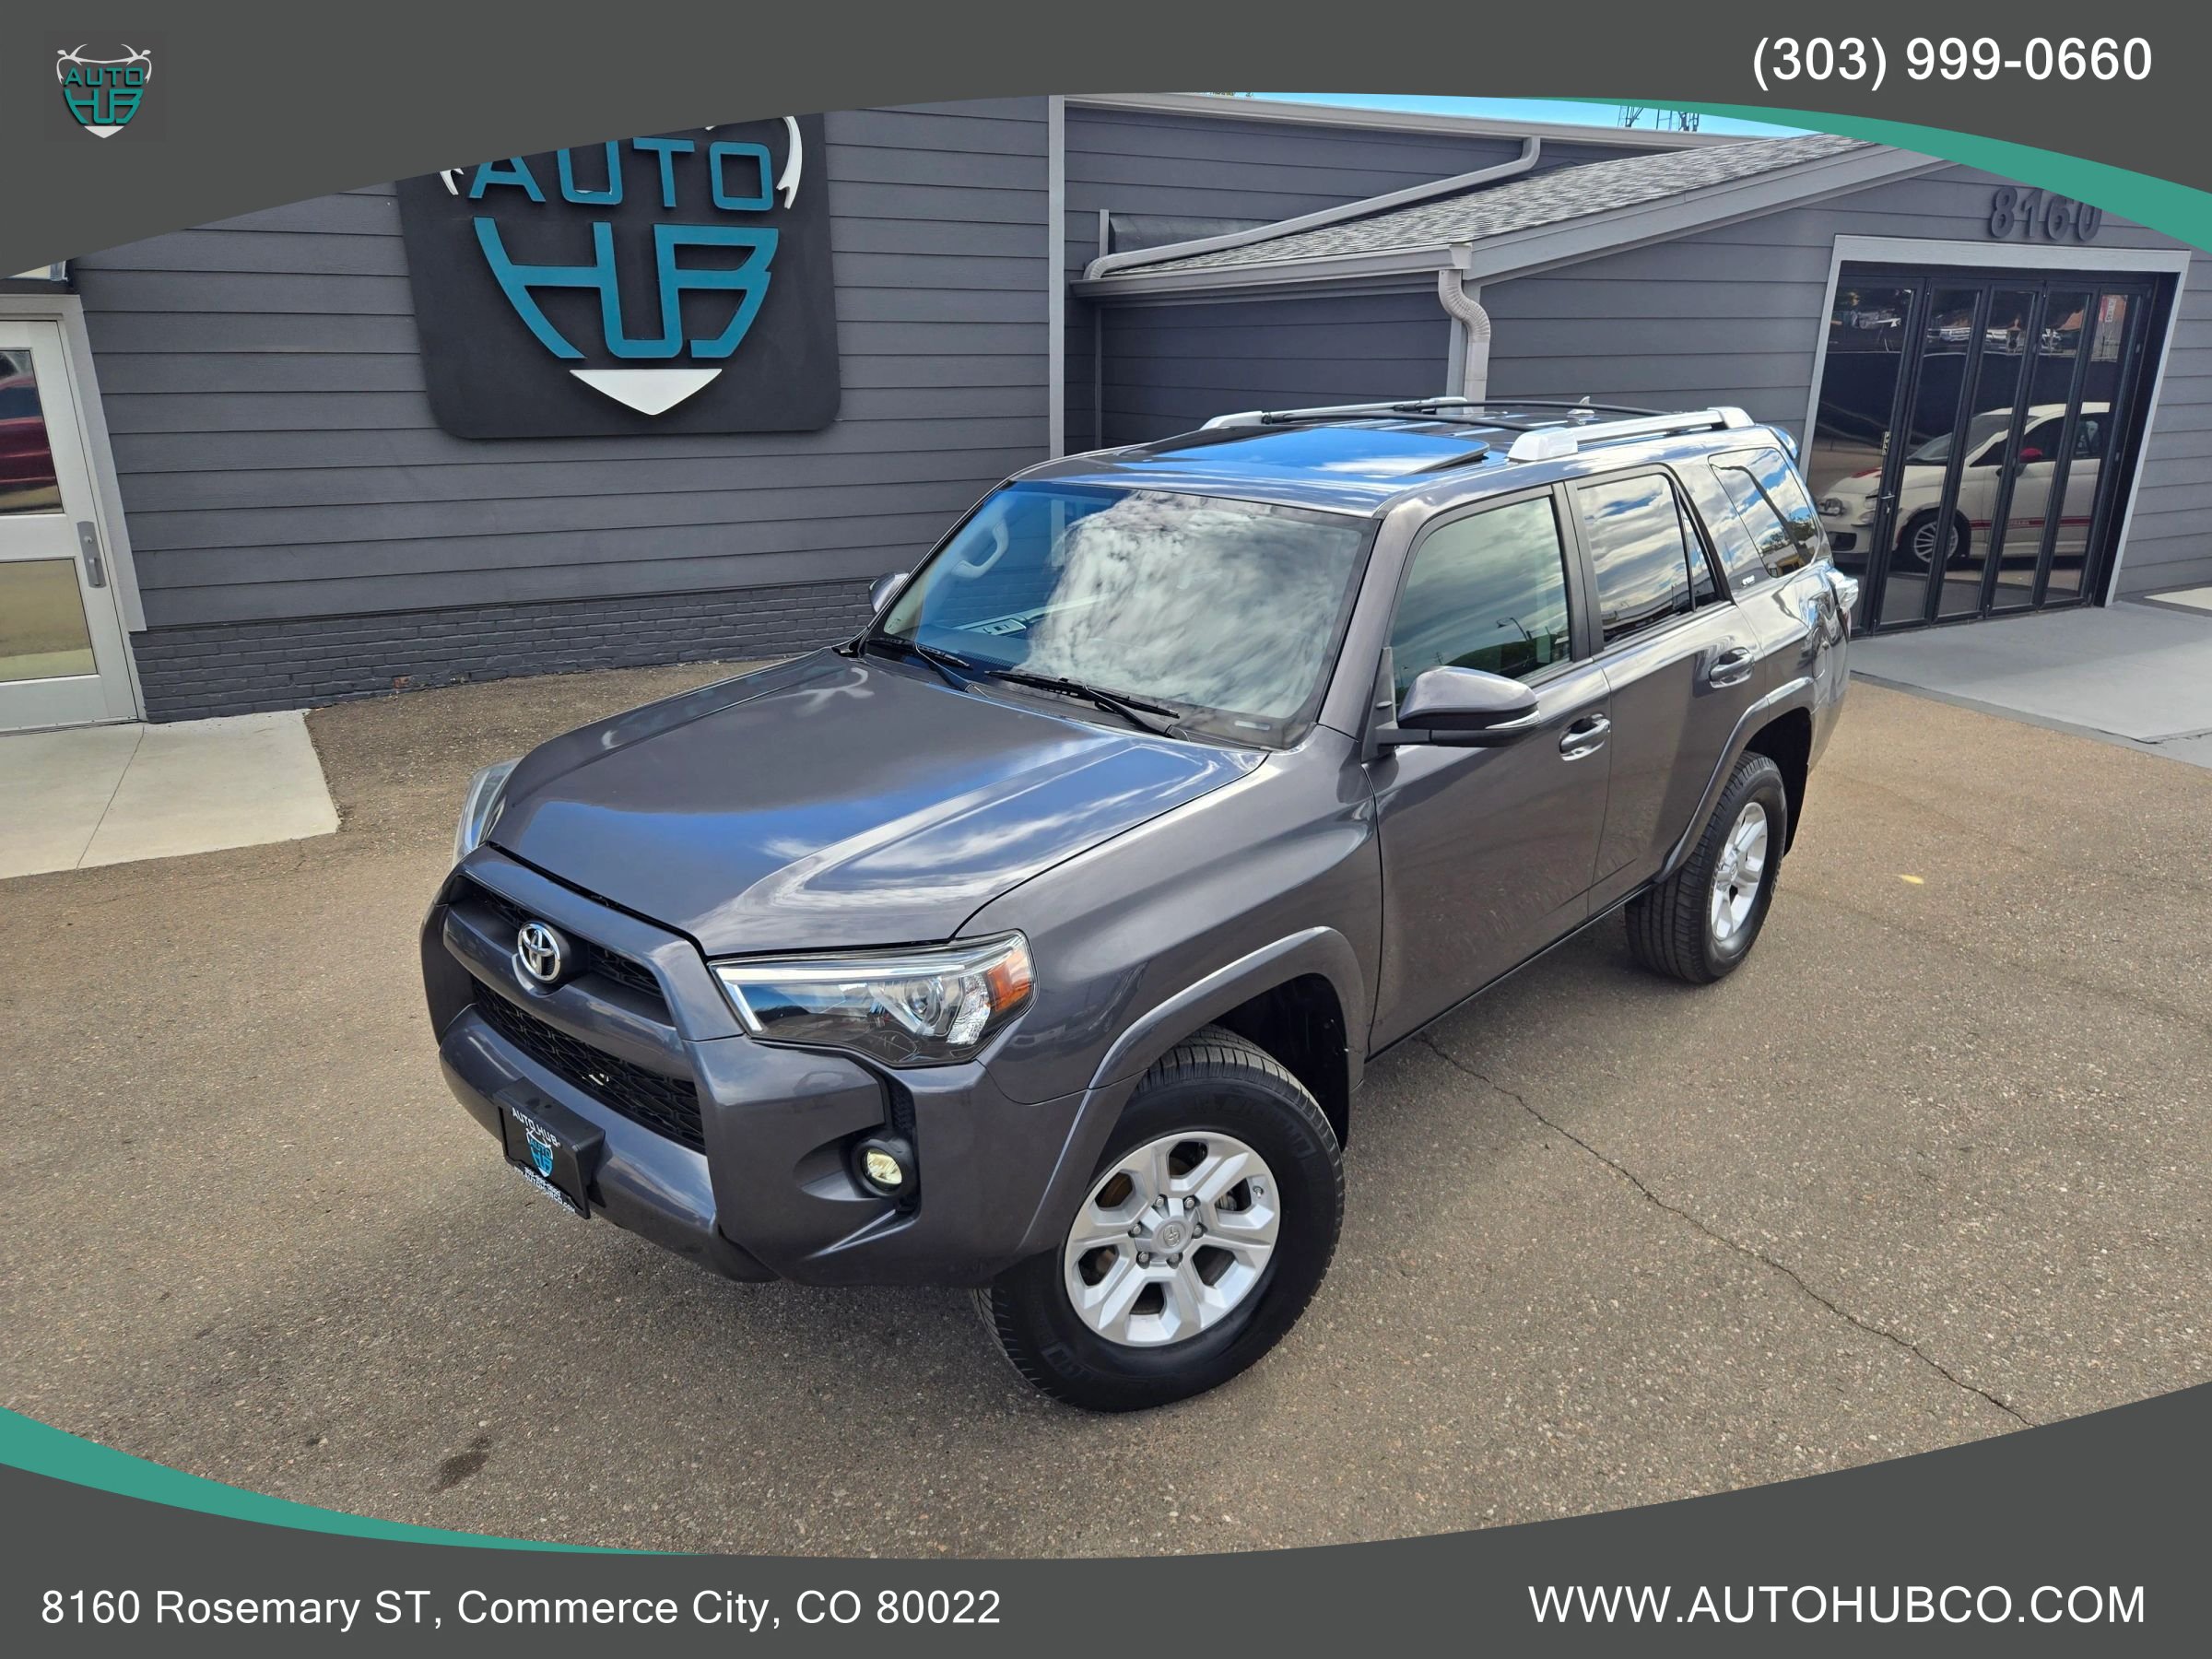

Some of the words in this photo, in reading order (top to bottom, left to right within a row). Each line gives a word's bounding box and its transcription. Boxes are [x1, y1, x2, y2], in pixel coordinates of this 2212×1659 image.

[468, 137, 774, 211] AUTO
[1989, 185, 2103, 241] 8160
[473, 217, 779, 359] HUB
[512, 1107, 536, 1132] AUTO
